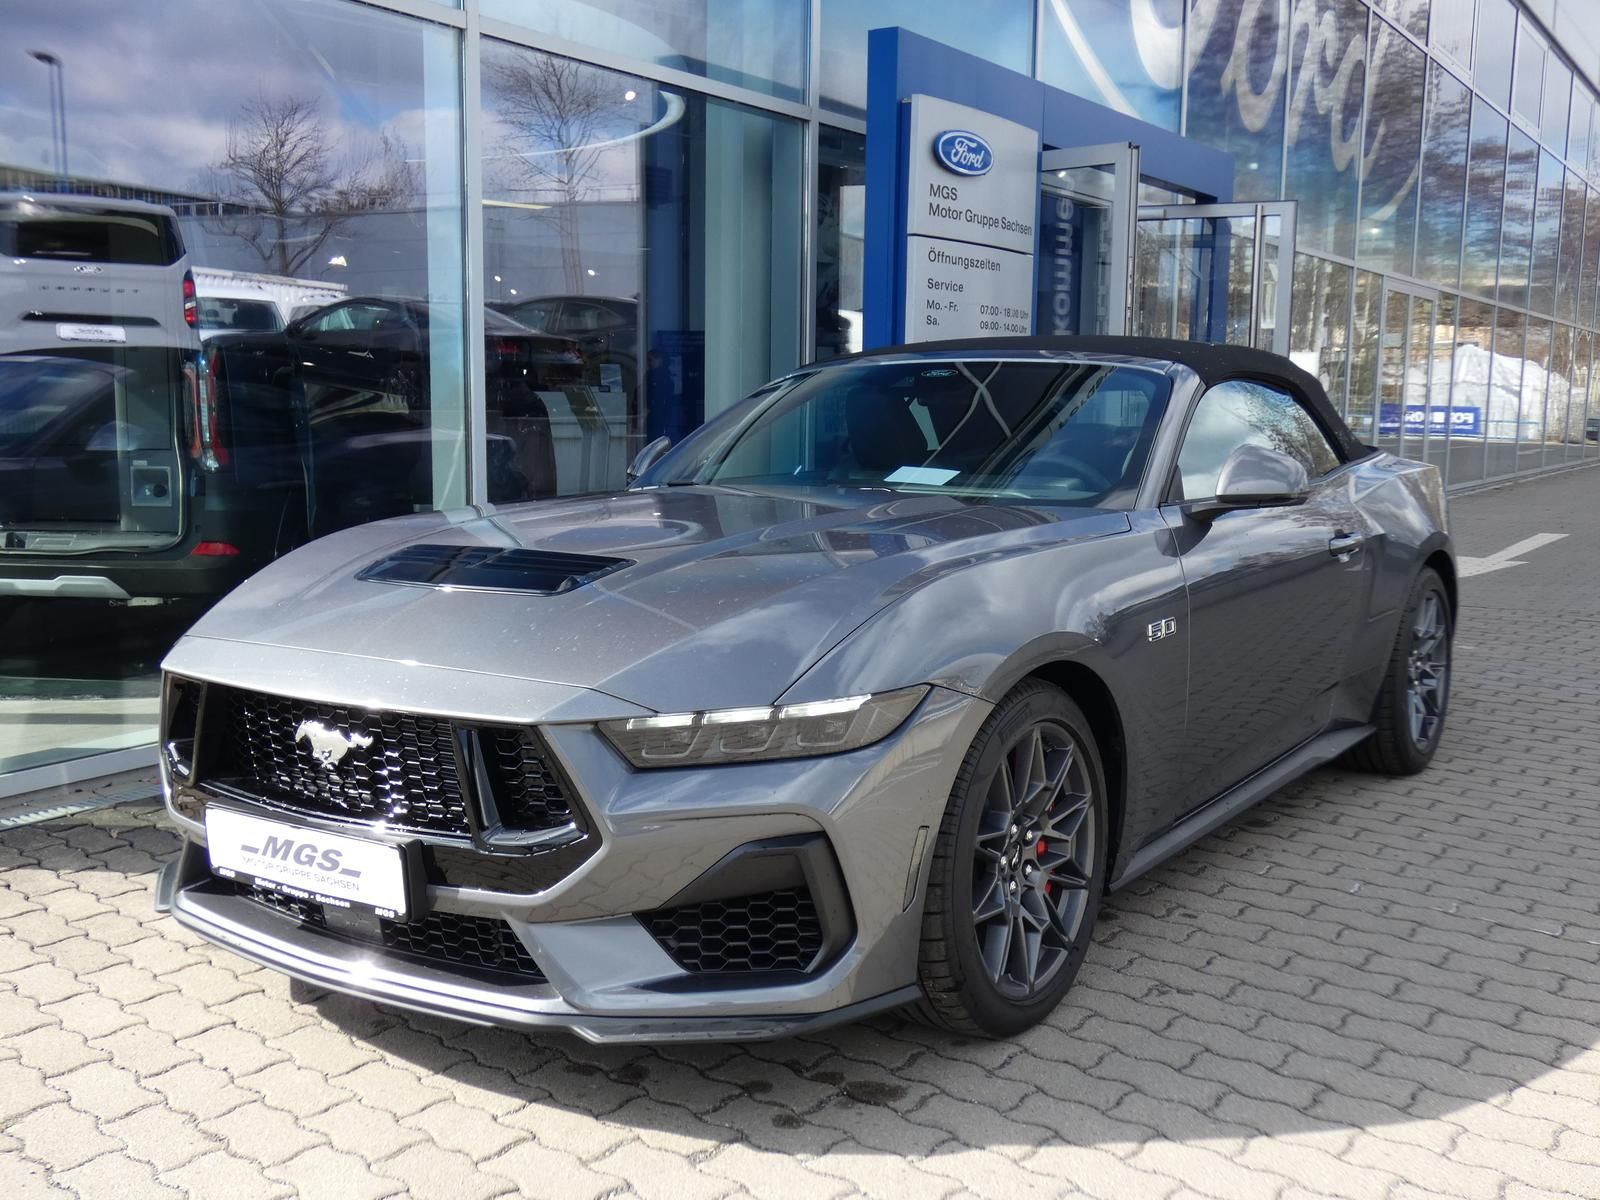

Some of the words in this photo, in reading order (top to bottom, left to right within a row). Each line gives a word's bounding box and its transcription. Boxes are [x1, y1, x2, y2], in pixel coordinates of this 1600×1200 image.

[951, 137, 985, 168] Ford
[929, 183, 958, 201] MGS
[928, 202, 962, 221] Motor
[964, 208, 1000, 230] Gruppe
[1000, 216, 1032, 236] Sachsen
[928, 246, 1001, 272] Öffnungszeiten
[927, 278, 964, 292] Service
[926, 299, 943, 311] Mo.
[948, 301, 959, 312] Fr.
[979, 304, 999, 317] 07.00
[926, 315, 940, 326] Sa.
[979, 320, 999, 331] 09.00
[1003, 323, 1019, 333] 14.00
[261, 835, 343, 872] MGS
[313, 872, 360, 892] SACHSEN
[315, 893, 350, 909] Sachsen
